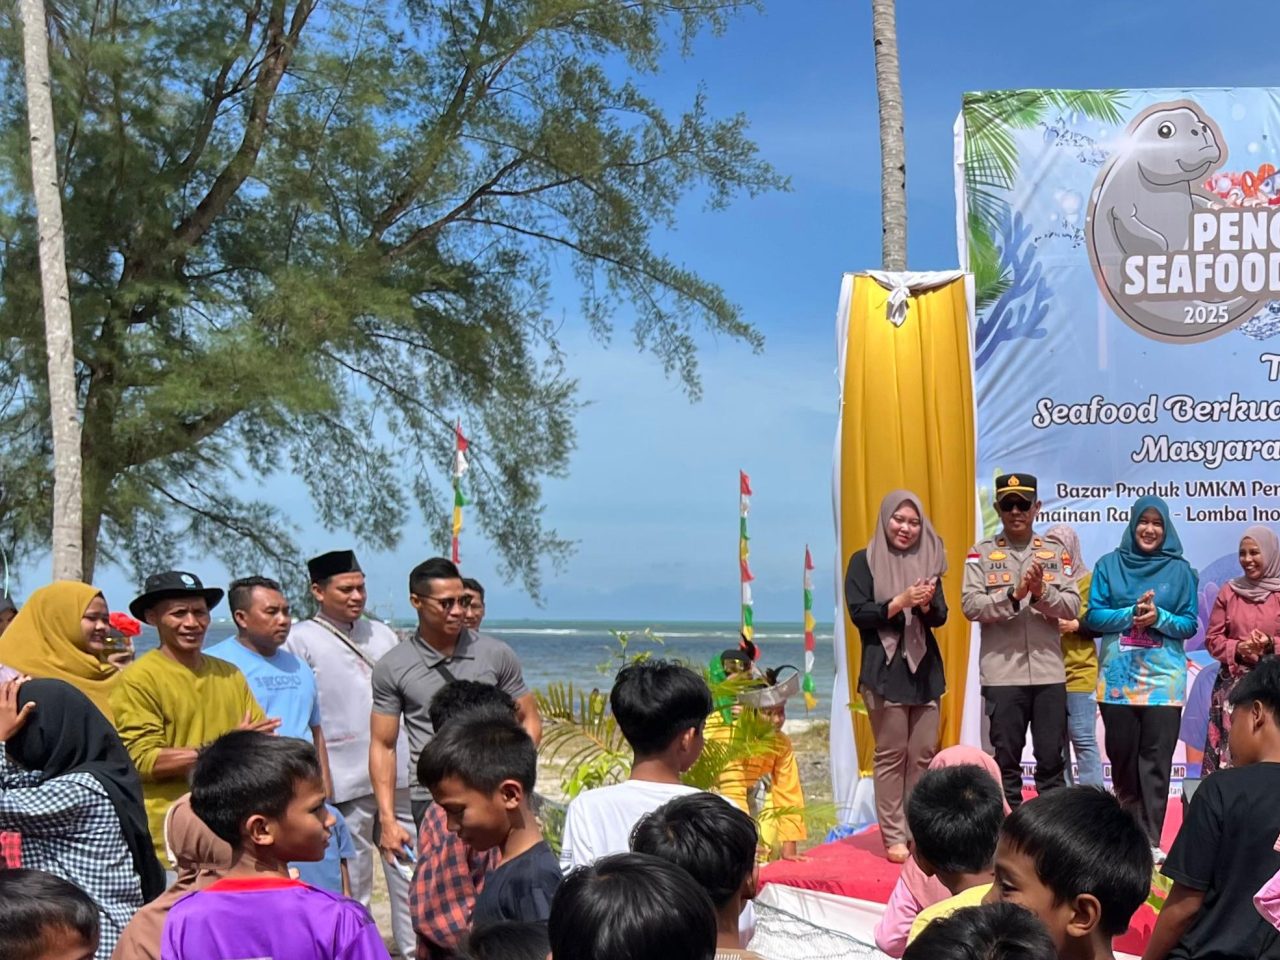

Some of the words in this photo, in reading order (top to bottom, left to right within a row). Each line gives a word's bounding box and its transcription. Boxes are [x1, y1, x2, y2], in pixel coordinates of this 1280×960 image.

[1183, 306, 1229, 324] 2025
[1032, 394, 1158, 429] Seafood
[1056, 483, 1111, 499] Bazar
[1116, 481, 1180, 498] Produk
[1185, 481, 1246, 497] UMKM
[1186, 505, 1247, 522] Lomba
